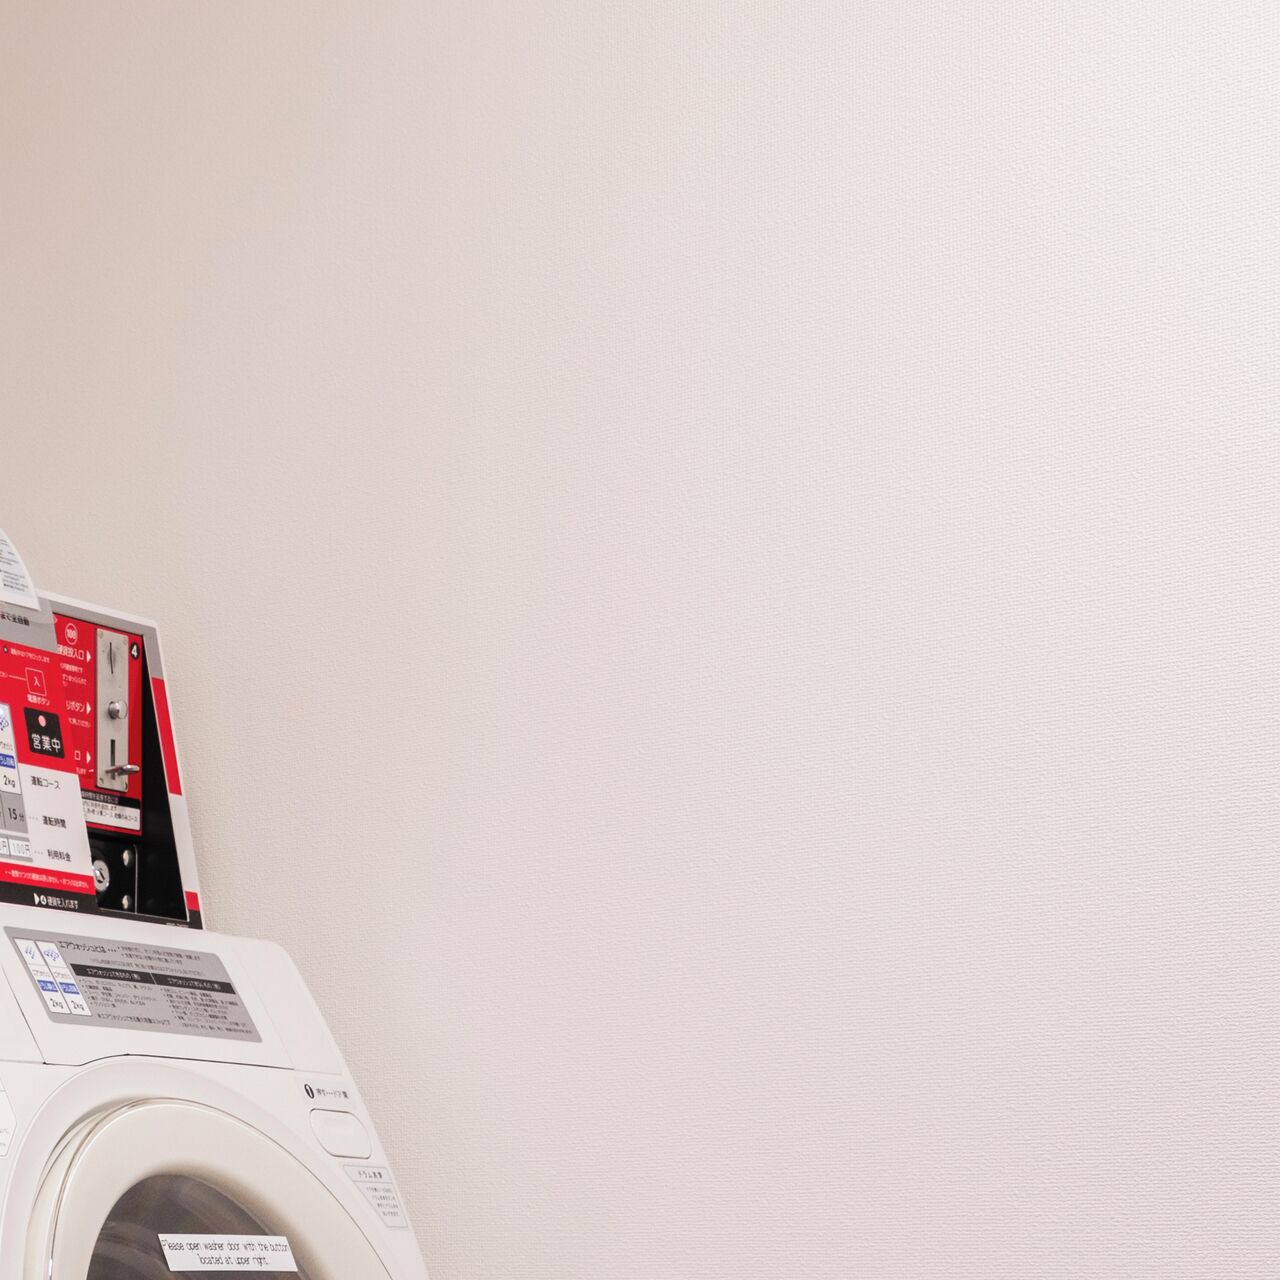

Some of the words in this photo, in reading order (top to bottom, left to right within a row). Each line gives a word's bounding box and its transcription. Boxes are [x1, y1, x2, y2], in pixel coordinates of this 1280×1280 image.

[30, 733, 62, 752] 営業中
[3, 774, 16, 789] 2kg
[30, 776, 61, 790] 運転コース
[186, 1243, 200, 1252] open
[204, 1242, 224, 1251] washer
[227, 1243, 239, 1251] door
[244, 1242, 256, 1251] with
[258, 1242, 268, 1251] the
[270, 1242, 288, 1252] button
[197, 1254, 223, 1265] located
[225, 1256, 233, 1265] at
[234, 1256, 250, 1265] upper
